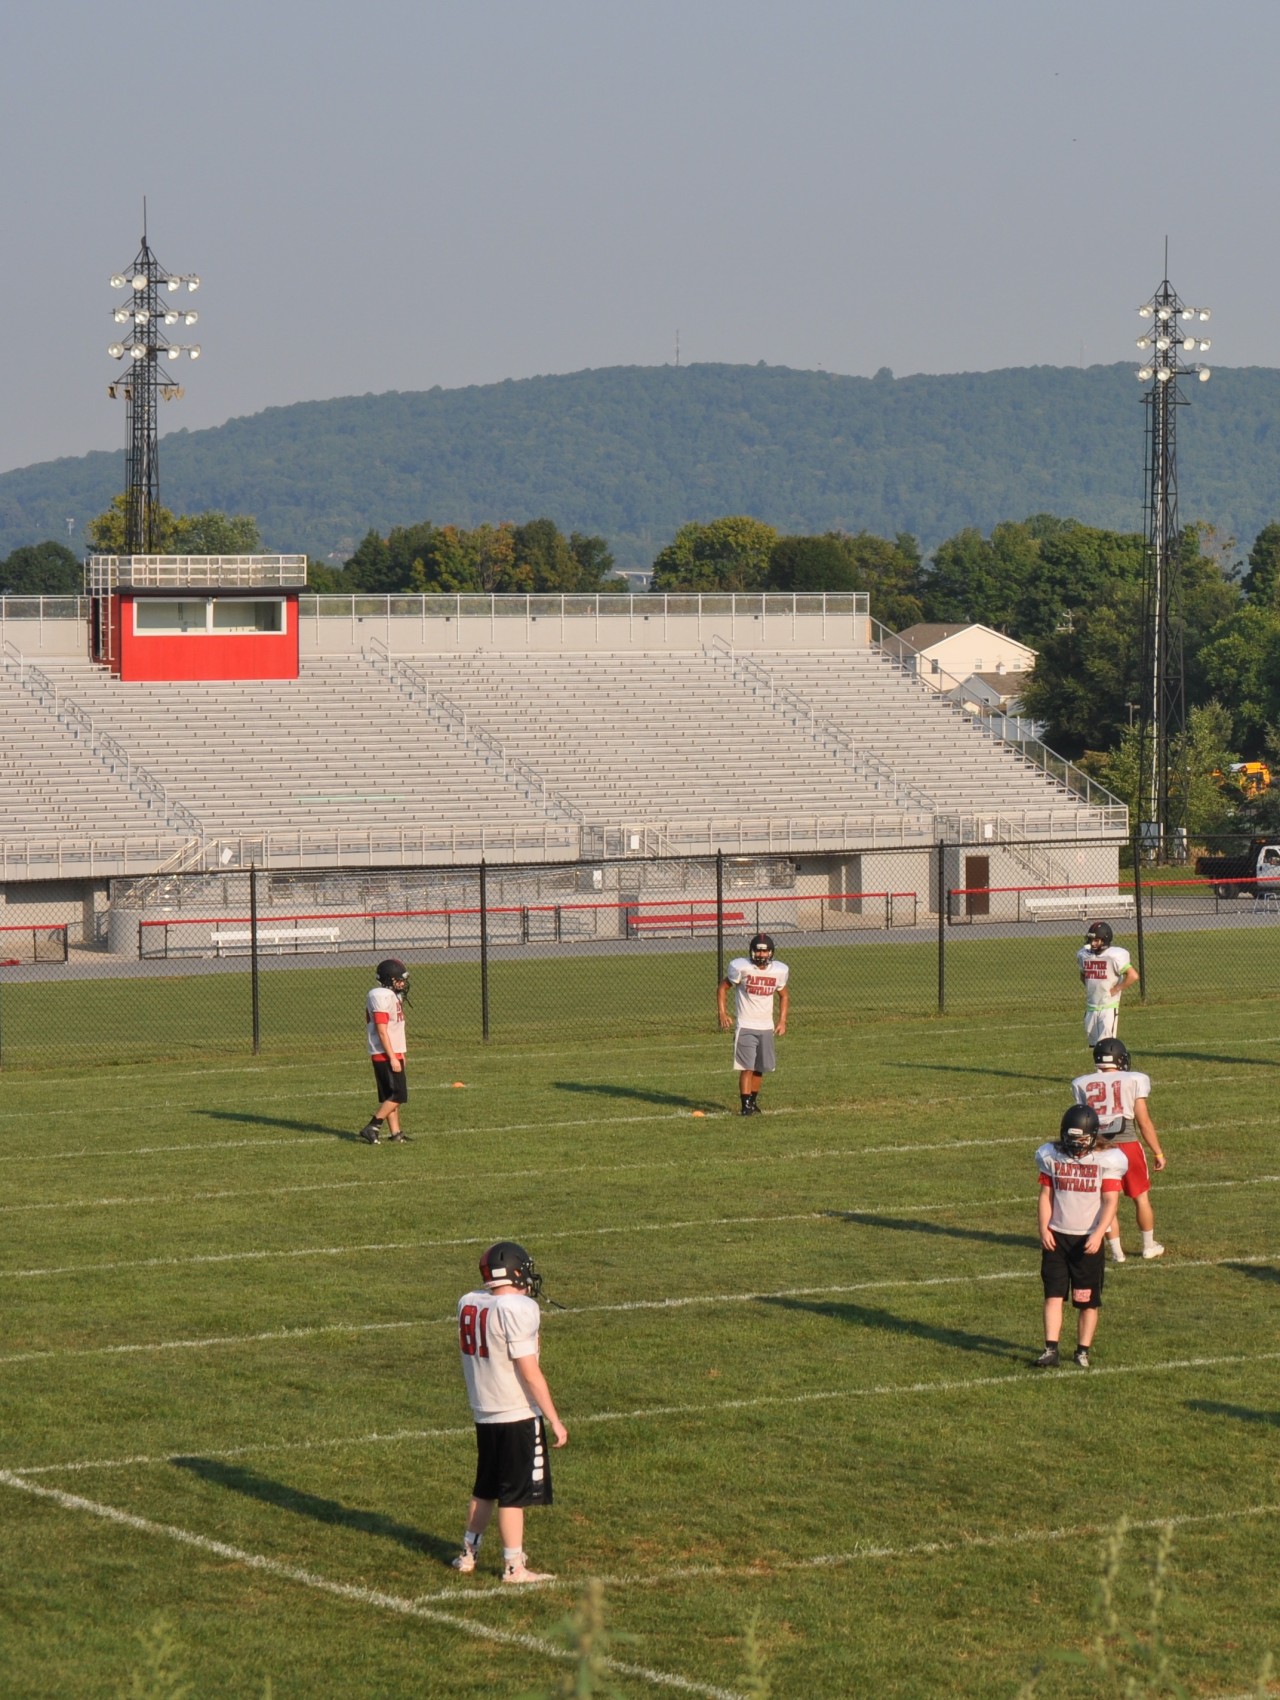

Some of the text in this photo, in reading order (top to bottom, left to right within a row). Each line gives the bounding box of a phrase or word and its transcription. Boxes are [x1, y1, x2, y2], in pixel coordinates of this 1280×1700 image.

[746, 974, 777, 987] PANTHER
[745, 984, 776, 997] FOOTBALL
[1085, 1080, 1124, 1116] 21
[1054, 1162, 1098, 1178] PANTHER
[1054, 1176, 1098, 1193] FOOTBALL
[460, 1304, 490, 1358] 81
